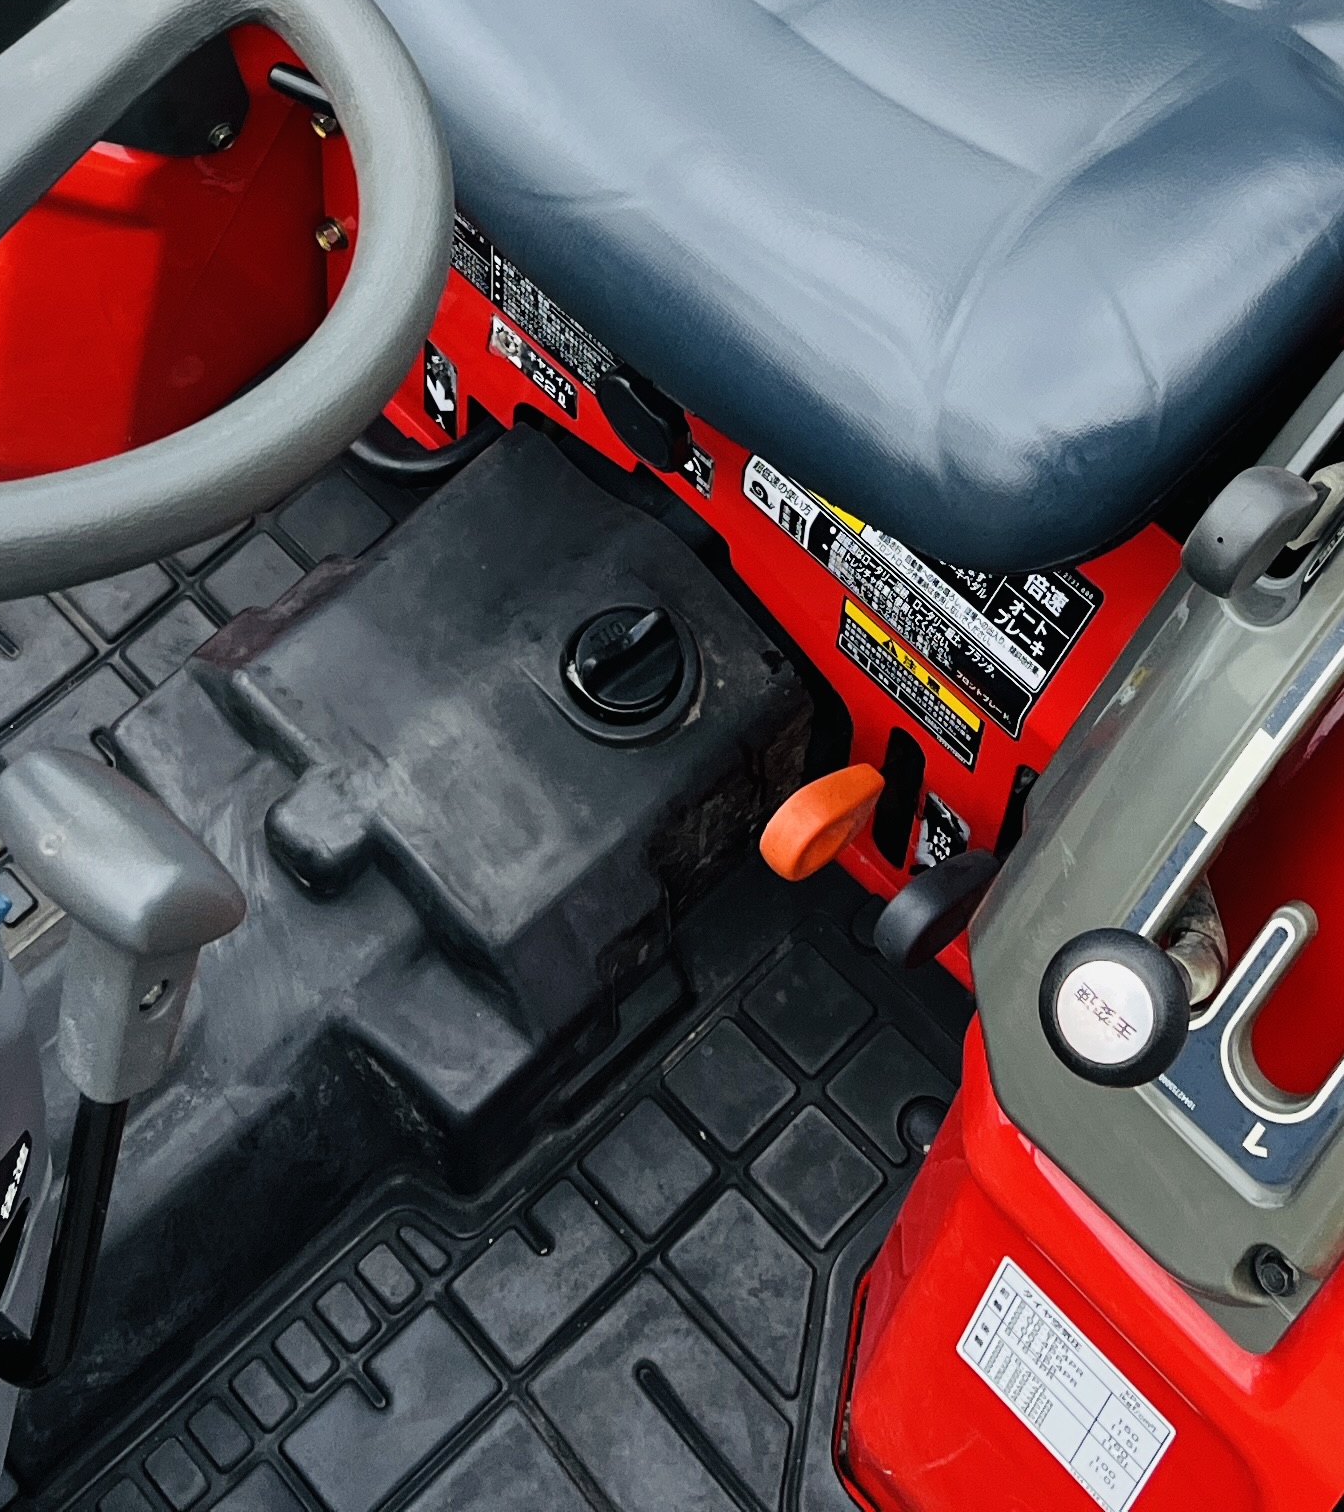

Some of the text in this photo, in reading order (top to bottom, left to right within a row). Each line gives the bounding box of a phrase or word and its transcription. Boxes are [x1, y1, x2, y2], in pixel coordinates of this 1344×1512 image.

[748, 458, 815, 518] 超低速の使い方
[1006, 597, 1051, 639] オート
[1020, 569, 1071, 617] 倍速
[990, 607, 1047, 659] ブレーキ
[1072, 983, 1134, 1045] 主変速
[1235, 1122, 1270, 1158] 1
